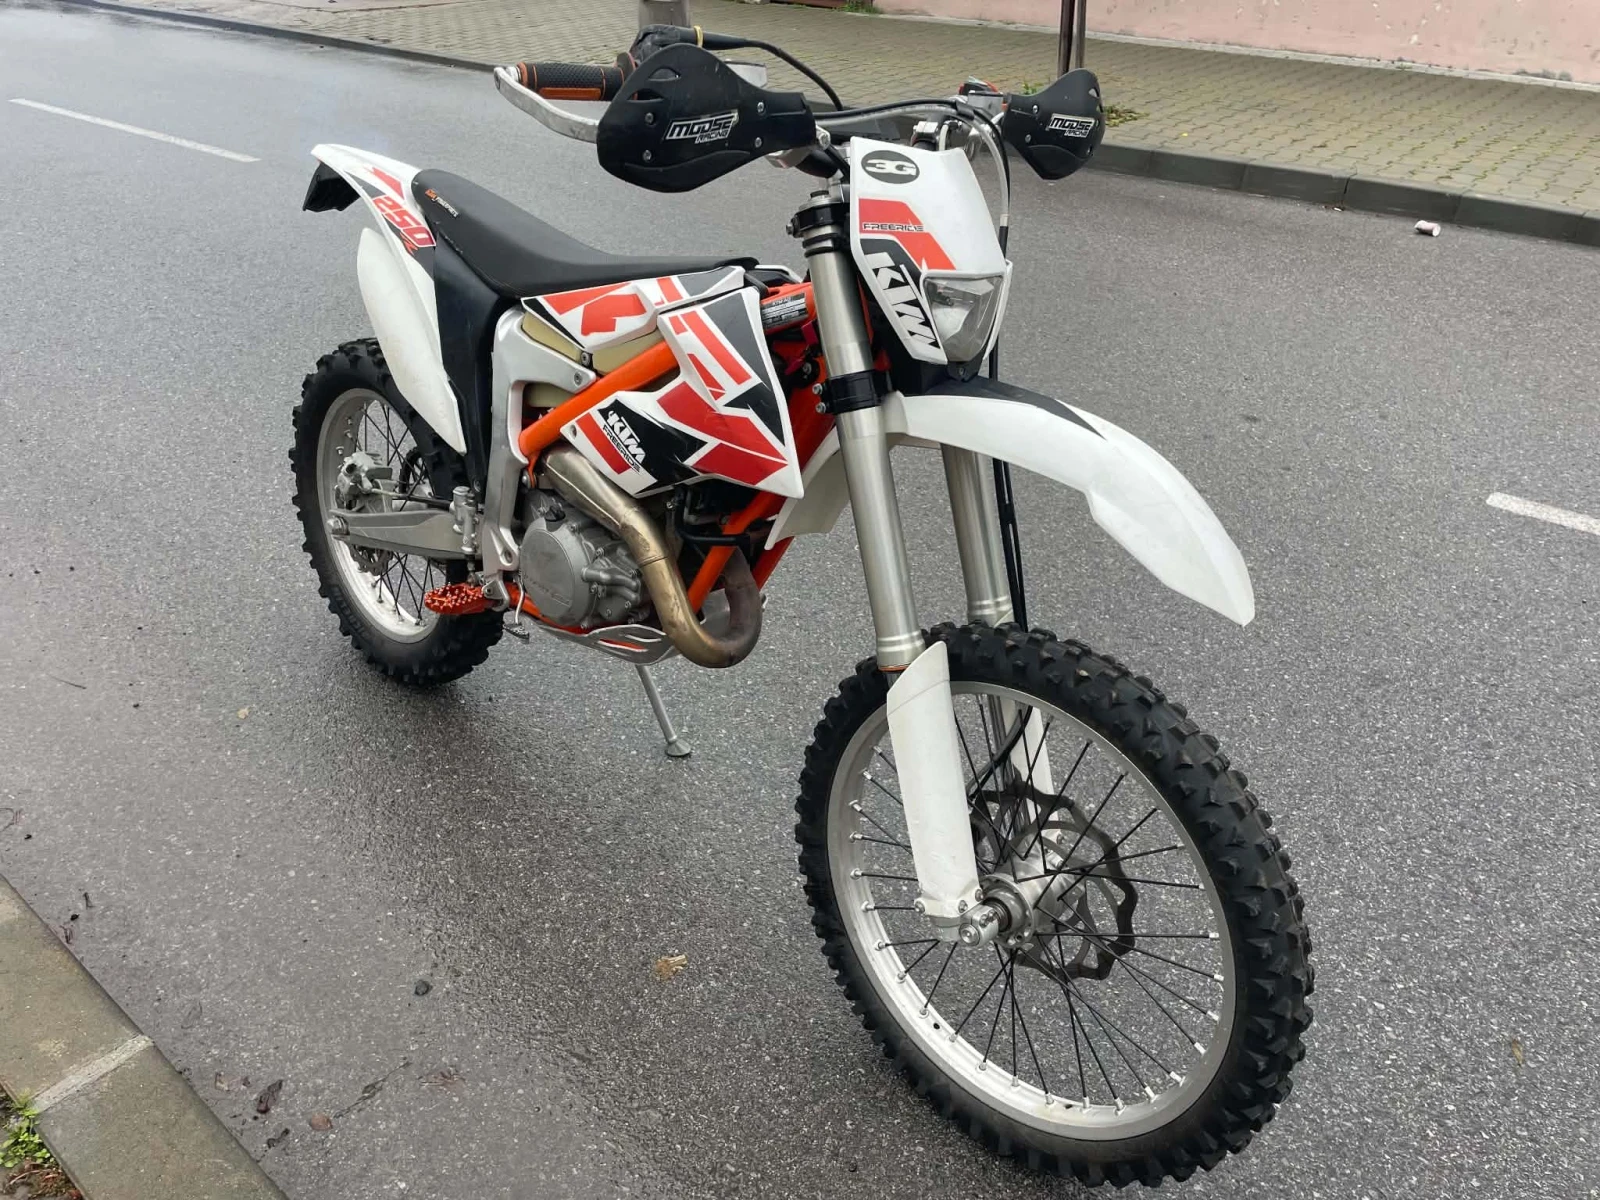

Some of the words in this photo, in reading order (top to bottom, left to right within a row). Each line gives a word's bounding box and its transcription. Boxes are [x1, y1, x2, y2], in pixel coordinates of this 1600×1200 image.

[667, 114, 736, 138] MOOSE
[1050, 117, 1092, 130] MOOSE
[695, 130, 729, 143] RACING
[865, 159, 917, 176] 3G
[372, 195, 437, 247] 250
[862, 222, 924, 232] FREERIDE
[865, 251, 940, 350] KTM
[603, 425, 641, 472] FREERIDE
[607, 410, 646, 464] KTM
